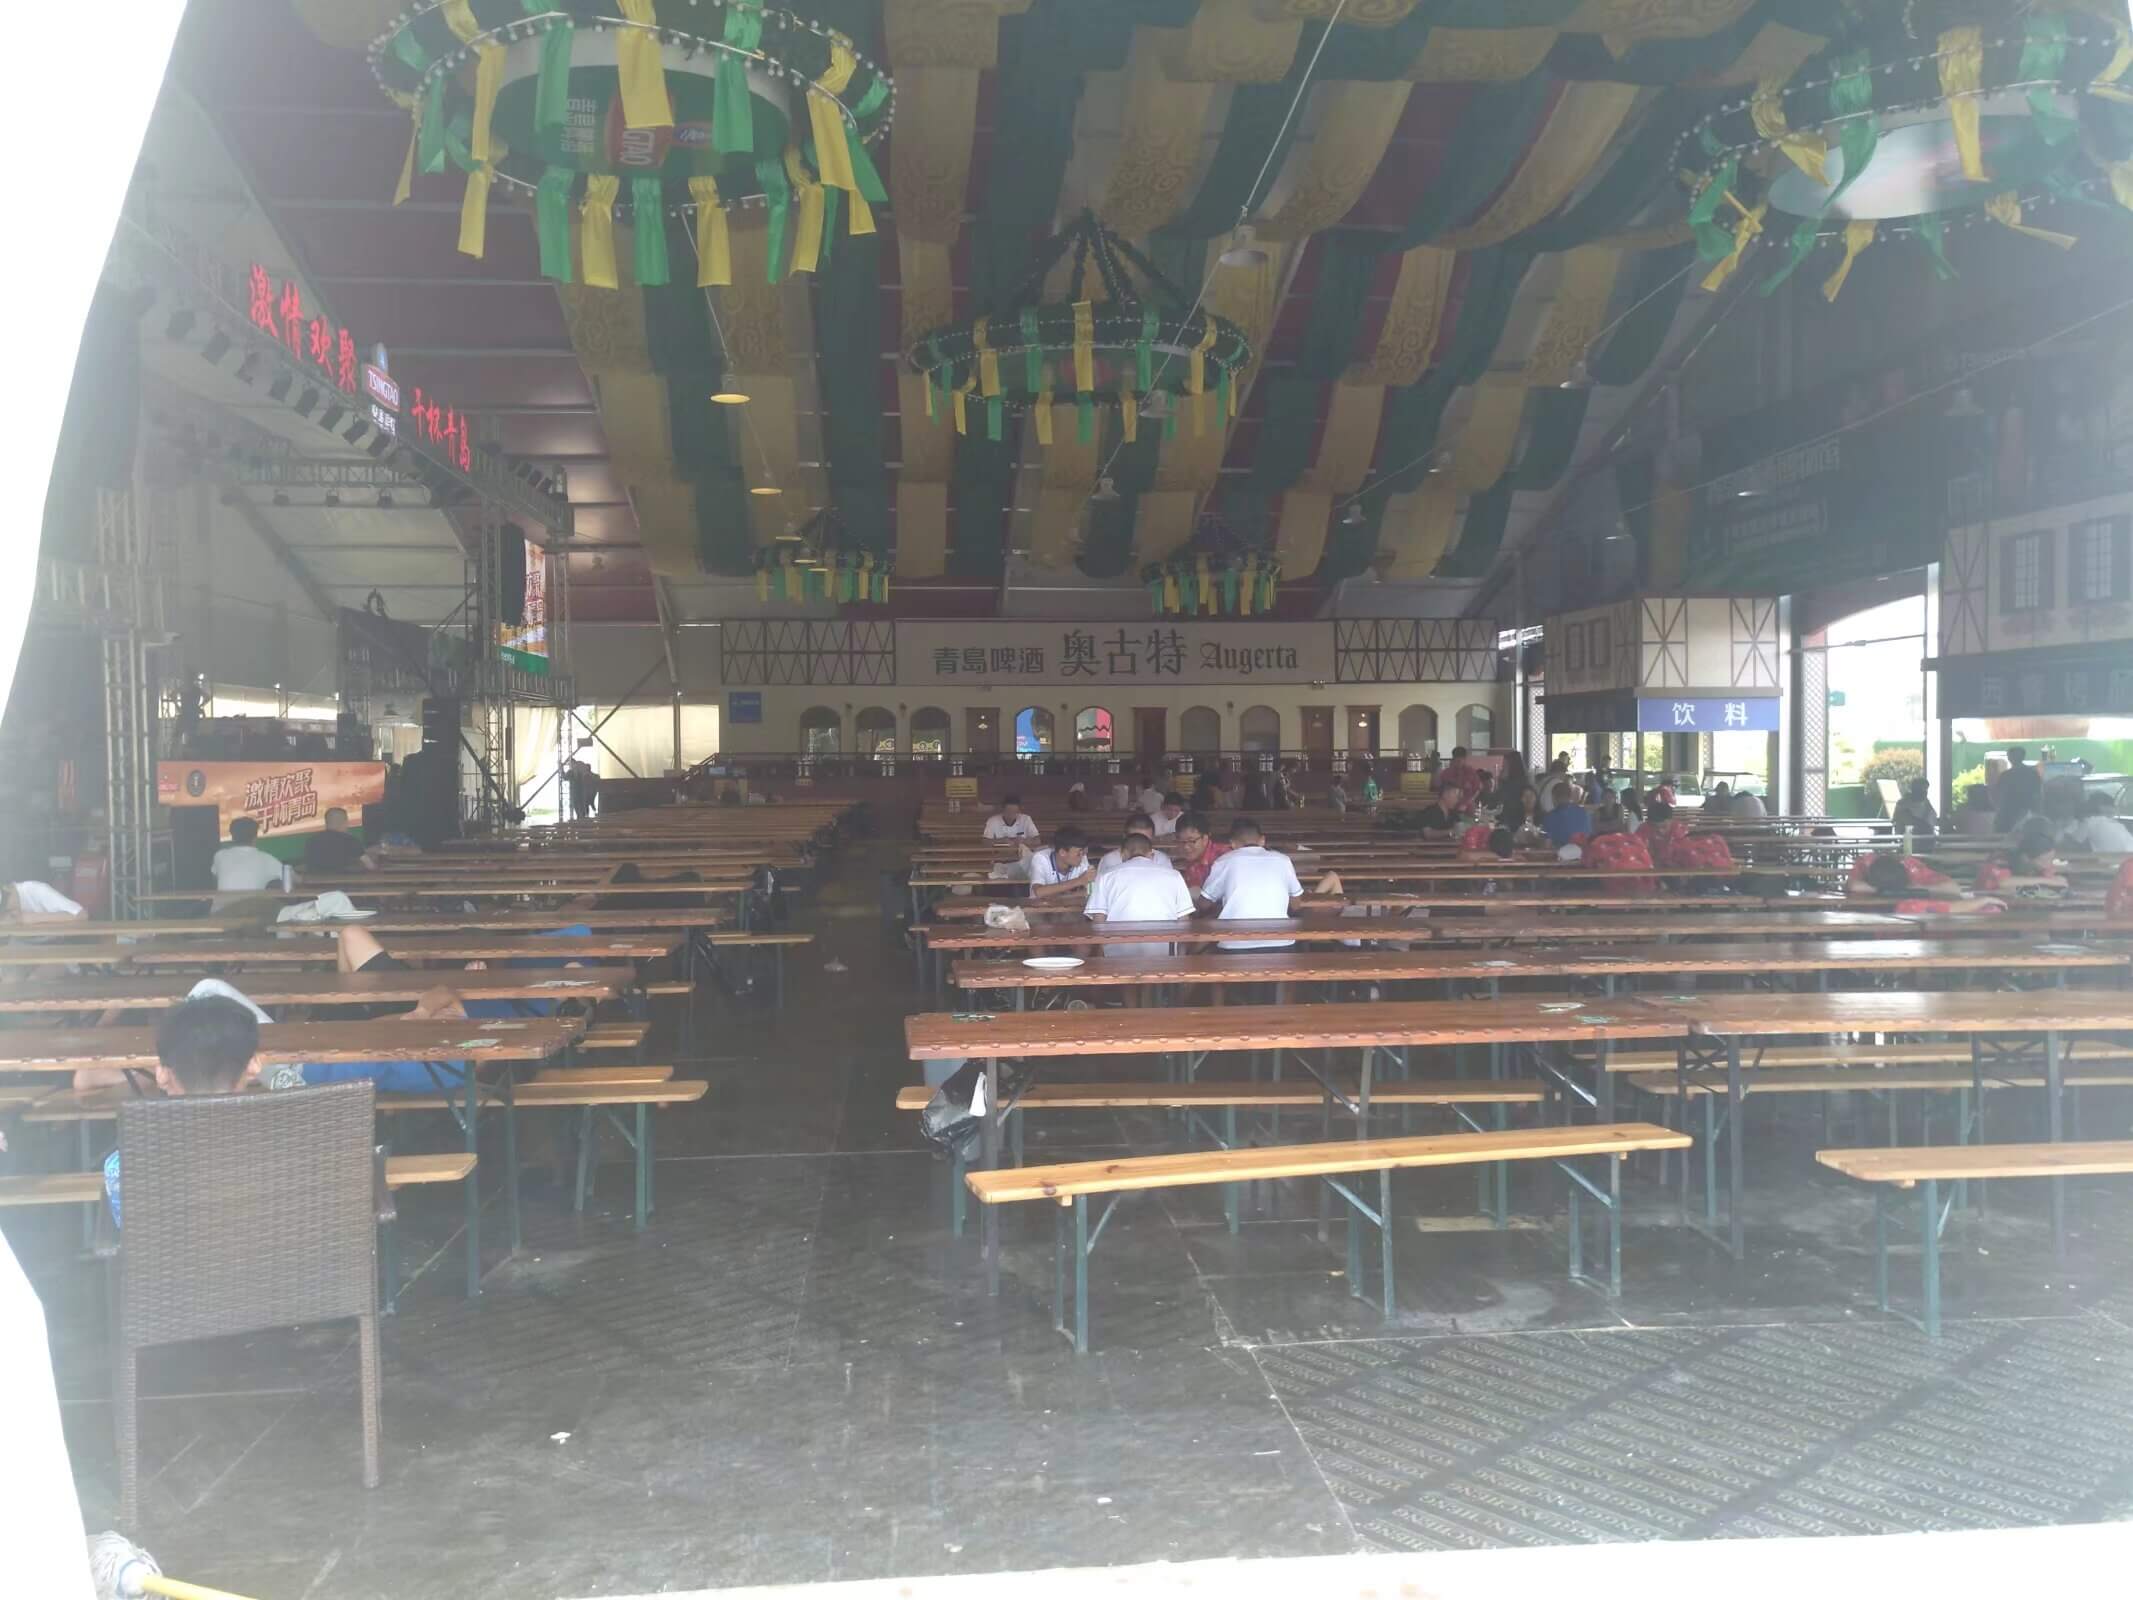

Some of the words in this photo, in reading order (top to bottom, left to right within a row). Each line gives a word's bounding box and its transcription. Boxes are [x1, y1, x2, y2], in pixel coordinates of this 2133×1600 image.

[249, 263, 358, 394] 激情欢聚
[367, 369, 399, 406] TSINGTAO
[1199, 641, 1298, 675] Augerta
[1672, 702, 1748, 727] 饮料
[244, 768, 313, 810] 激情欢聚
[255, 790, 318, 834] 干杯青岛
